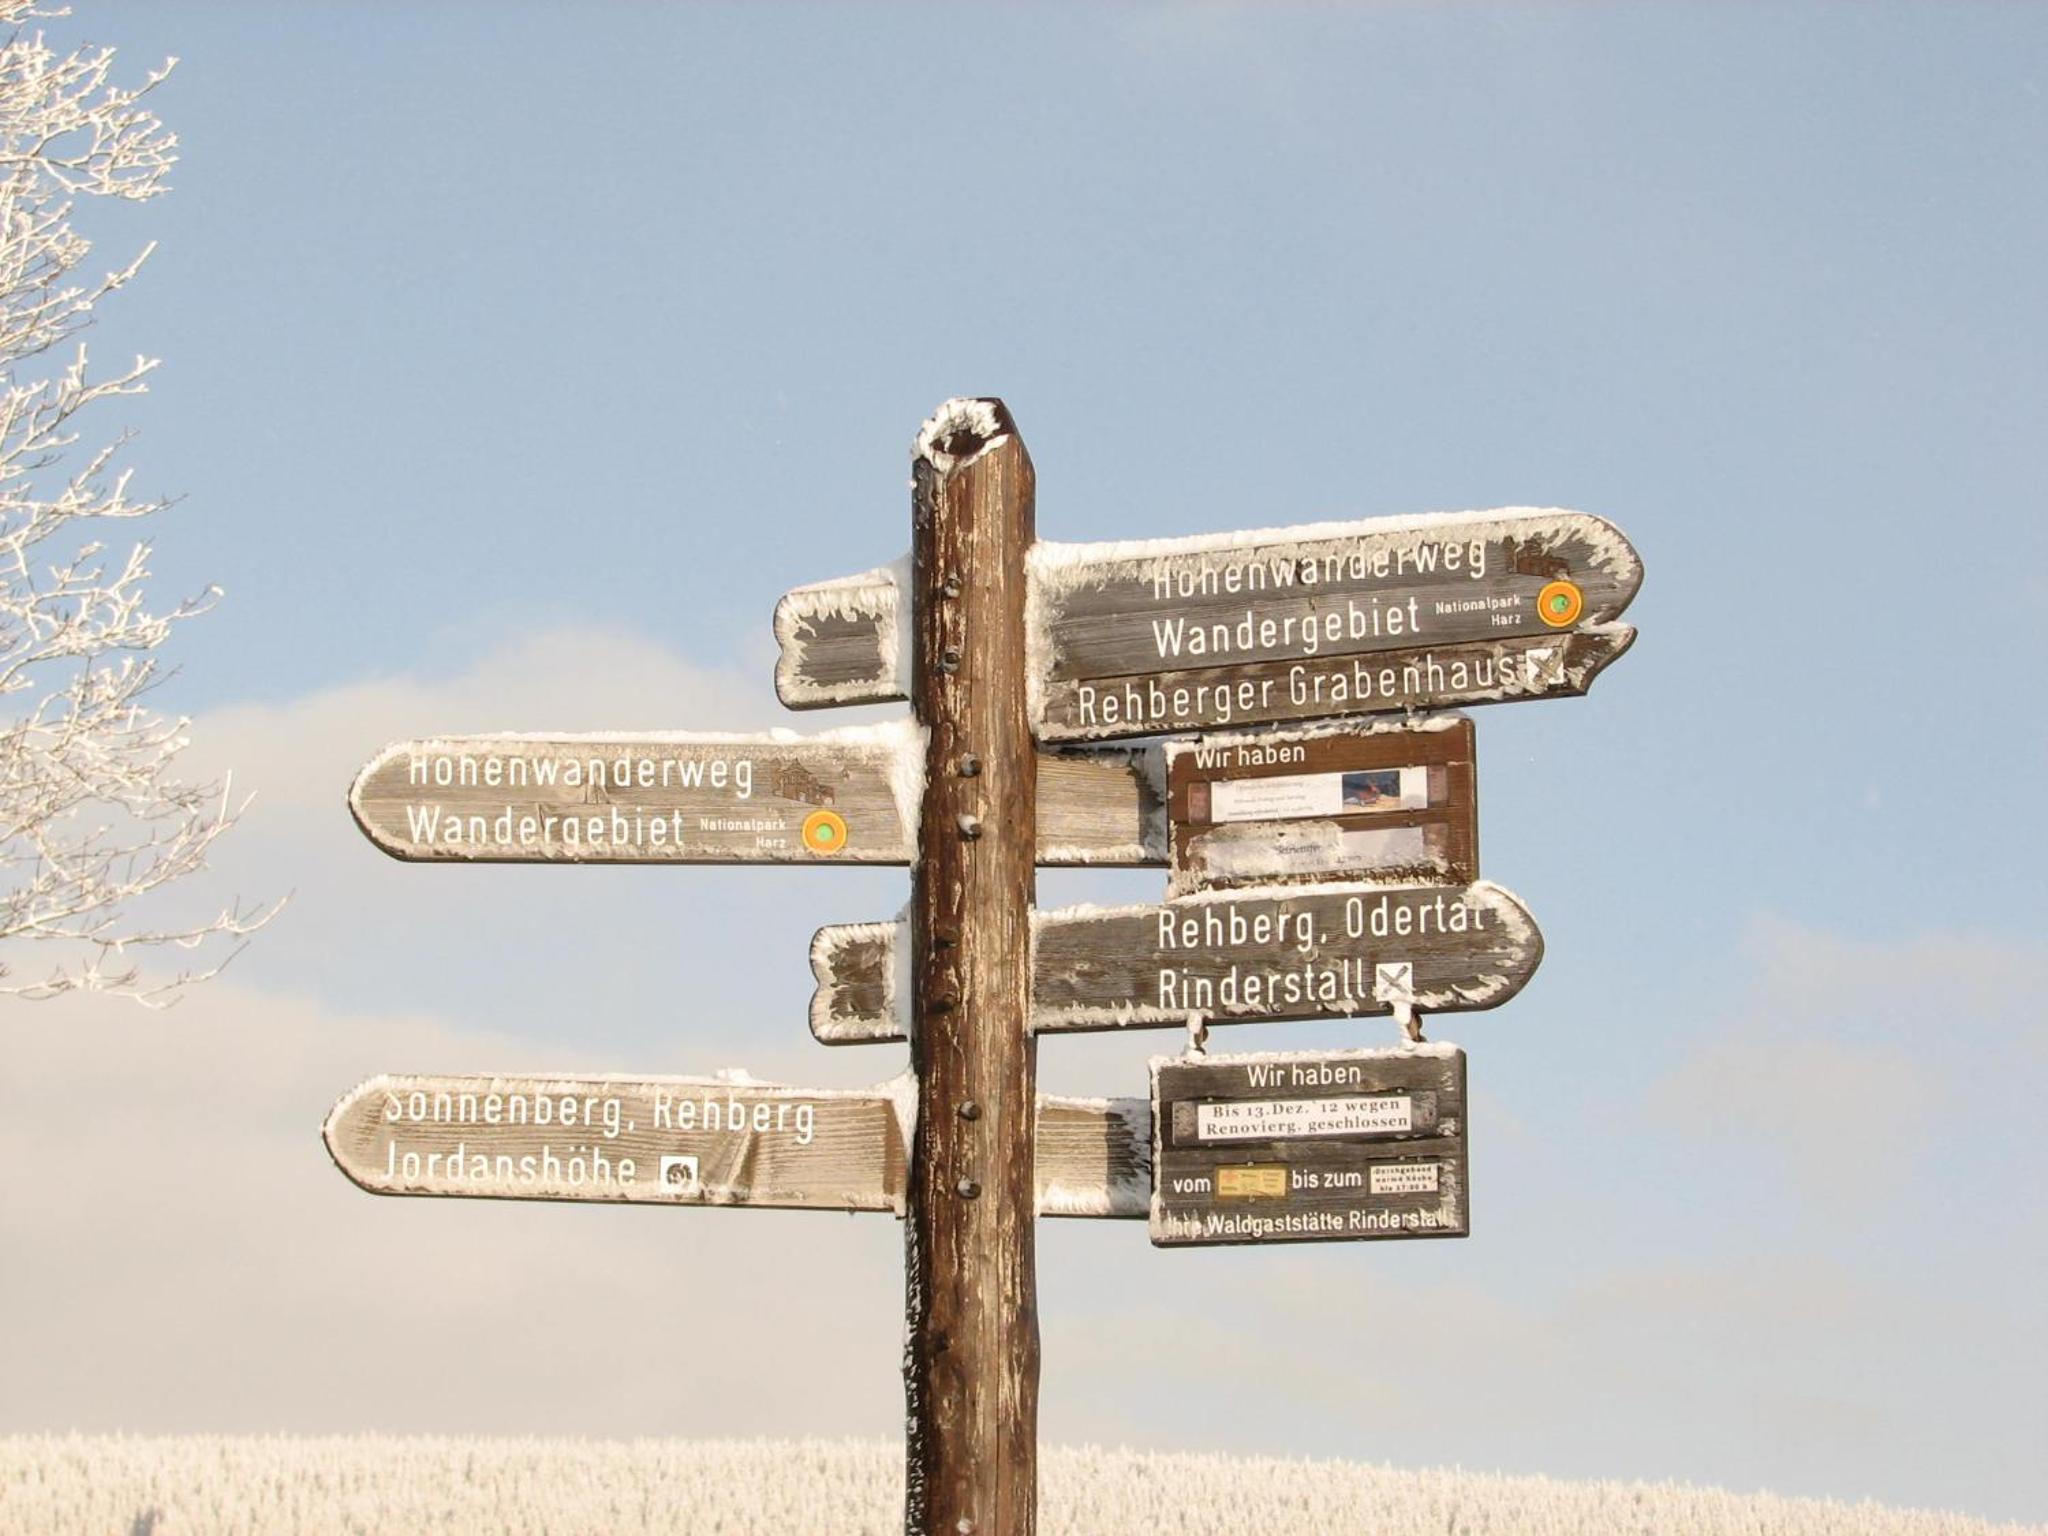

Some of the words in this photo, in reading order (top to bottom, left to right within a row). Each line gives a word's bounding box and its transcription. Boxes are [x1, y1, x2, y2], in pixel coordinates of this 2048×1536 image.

[1435, 594, 1521, 614] Nationalpark
[1152, 597, 1420, 658] Wandergebiet
[1491, 613, 1521, 626] Harz
[1078, 678, 1275, 725] Rehberger
[1288, 652, 1516, 705] Grabenhaus
[1195, 746, 1231, 769] Wir
[1238, 745, 1305, 766] haben
[406, 805, 683, 846] Wandergebiet
[700, 817, 786, 833] Nationalpark
[756, 836, 786, 849] Harz
[1158, 906, 1328, 952] Rehberg,
[1158, 958, 1366, 1008] Rinderstall
[1247, 1065, 1286, 1088] Wir
[1292, 1063, 1361, 1085] haben
[384, 1091, 636, 1138] Sonnenberg,
[653, 1092, 815, 1145] Rehberg
[1213, 1105, 1240, 1118] Bis
[1320, 1103, 1339, 1113] 12
[1345, 1099, 1401, 1114] wegen
[1308, 1115, 1409, 1132] geschlossen
[380, 1140, 637, 1188] Jordanshöhe
[1173, 1176, 1211, 1194] vom
[1292, 1169, 1317, 1189] bis
[1323, 1170, 1362, 1188] zum
[1206, 1211, 1343, 1237] Waldgaststätte
